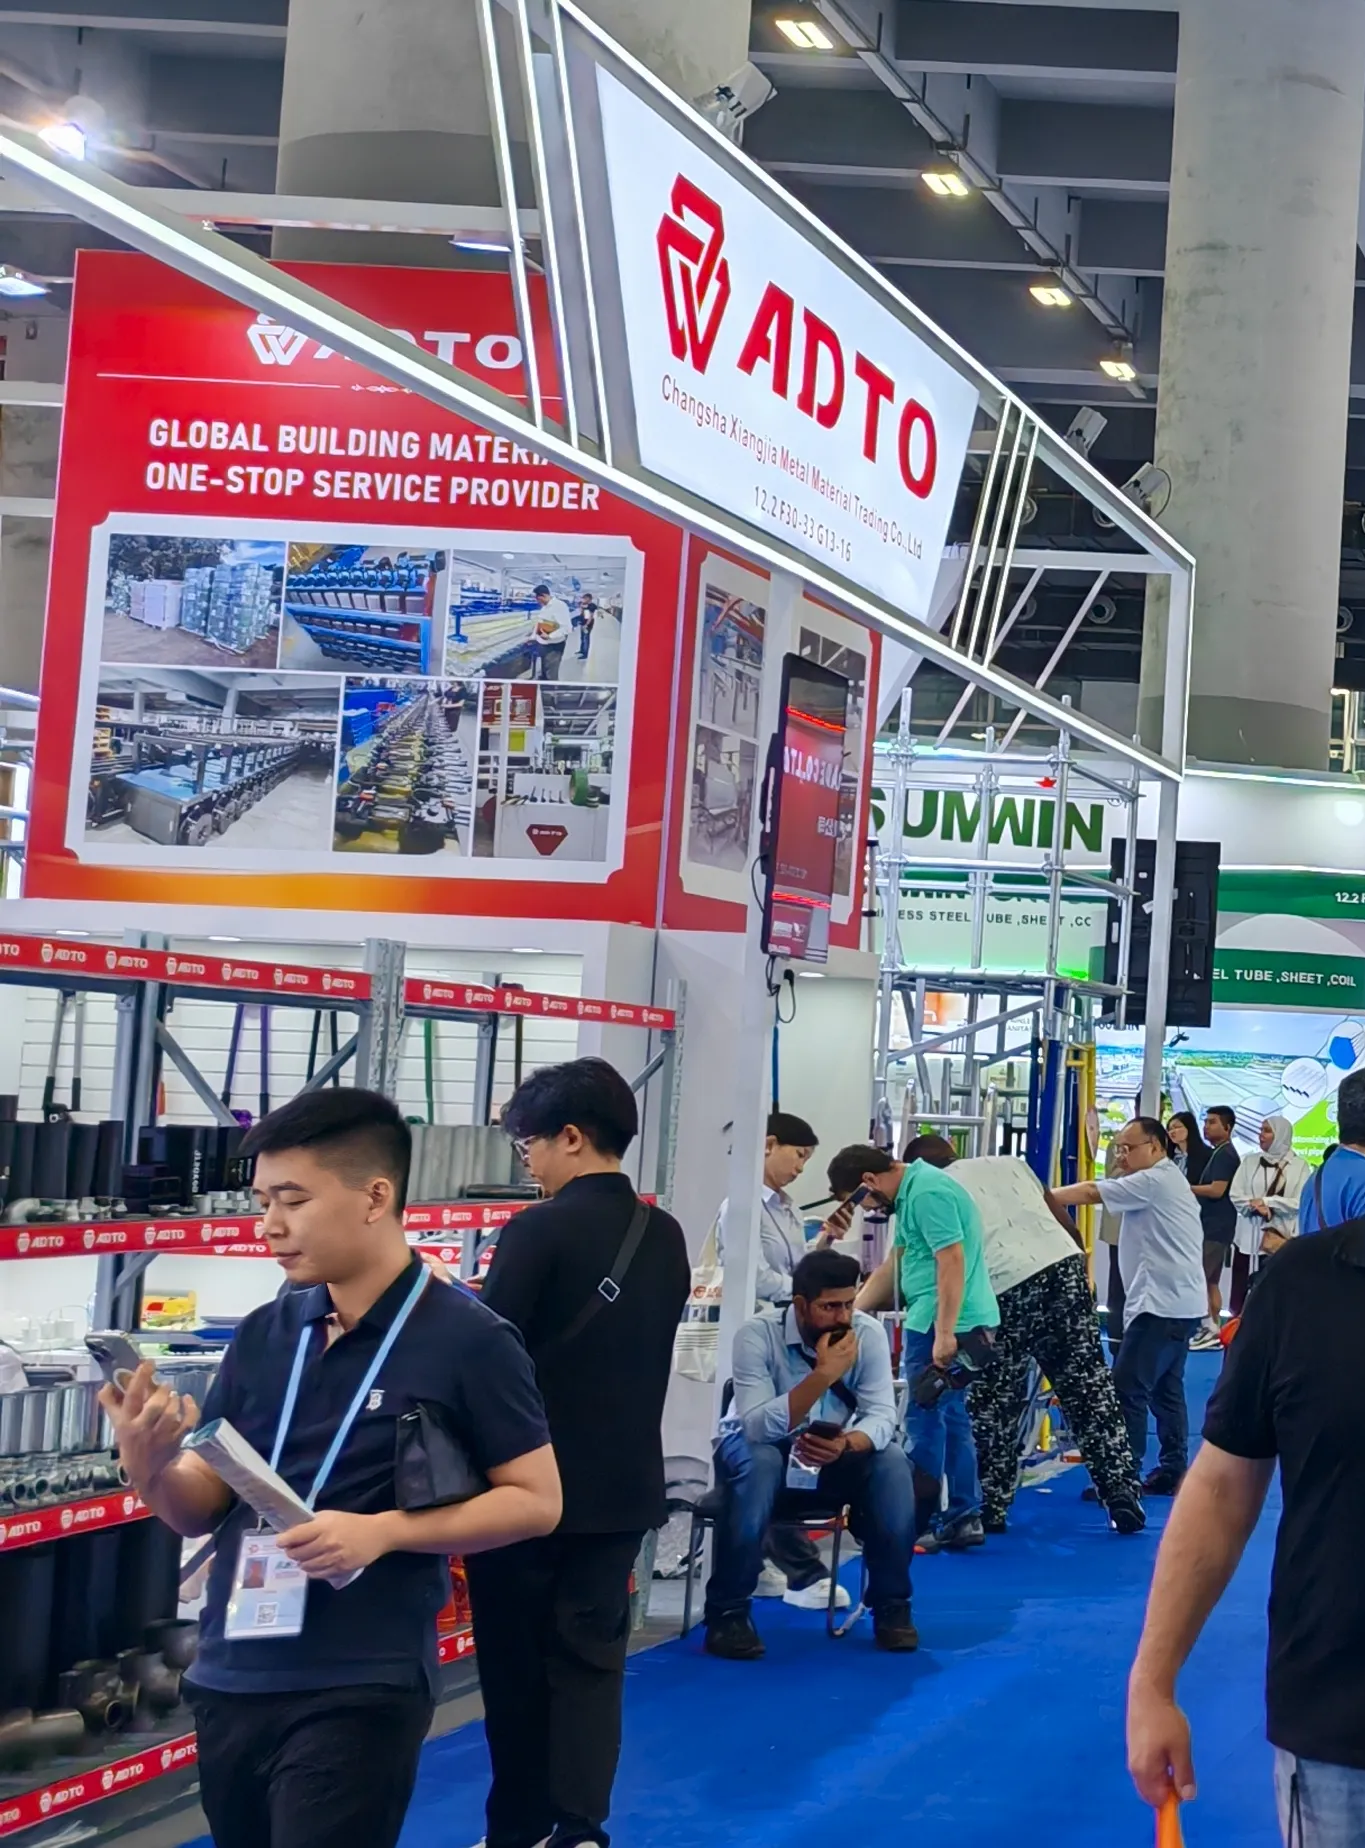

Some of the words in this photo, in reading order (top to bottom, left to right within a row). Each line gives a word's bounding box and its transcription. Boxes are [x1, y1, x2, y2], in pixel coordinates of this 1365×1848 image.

[736, 280, 938, 500] ADTO
[149, 418, 269, 452] GLOBAL
[278, 424, 421, 460] BUILDING
[428, 432, 549, 466] MATER
[661, 373, 727, 435] Changsha
[729, 413, 778, 465] Xiangjia
[779, 445, 810, 486] Metal
[811, 465, 852, 512] Material
[854, 494, 889, 545] Trading
[145, 462, 304, 497] ONE-STOP
[312, 468, 442, 504] SERVICE
[449, 476, 600, 511] PROVIDER
[754, 485, 778, 519] 12.2
[779, 503, 815, 539] F30-33
[816, 521, 852, 563] G13-16
[929, 910, 971, 923] STEEL
[986, 913, 1013, 925] UBE
[1017, 914, 1065, 927] ,SHET
[55, 949, 87, 964] ADTO
[118, 955, 149, 969] ADTO
[177, 961, 206, 976] ADTO
[232, 967, 260, 980] ADTO
[1234, 969, 1273, 982] TUBE
[30, 1236, 65, 1249] ADTO
[96, 1231, 127, 1244] ADTO
[156, 1228, 187, 1241] ADTO
[212, 1226, 240, 1238] ADTO
[227, 1243, 267, 1253] ADTO
[8, 1520, 42, 1539] ADTO
[74, 1506, 106, 1524] ADTO
[52, 1784, 85, 1804] ADTO
[113, 1763, 144, 1782] ADTO
